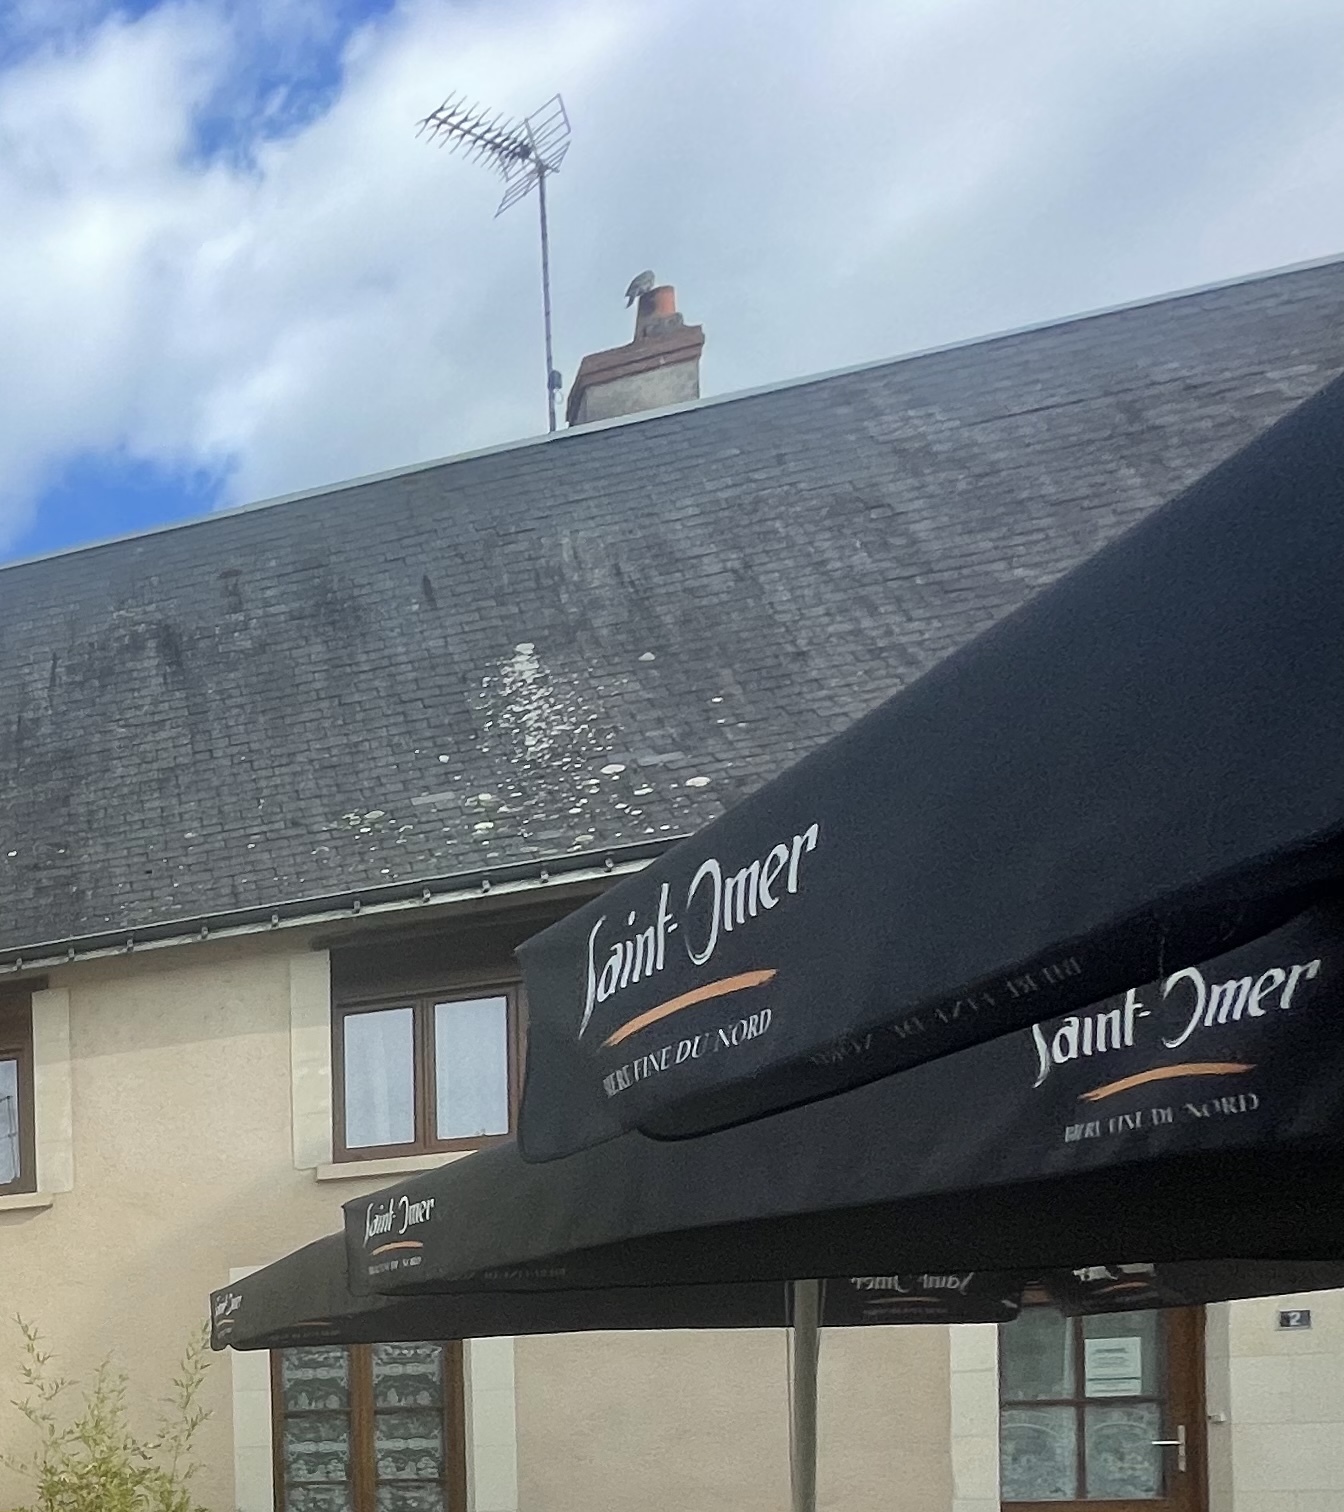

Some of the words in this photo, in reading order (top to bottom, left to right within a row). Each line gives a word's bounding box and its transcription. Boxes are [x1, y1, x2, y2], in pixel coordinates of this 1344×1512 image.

[578, 823, 819, 1040] Saint-Omer
[633, 1045, 673, 1081] FINE
[1288, 1311, 1301, 1326] 2
